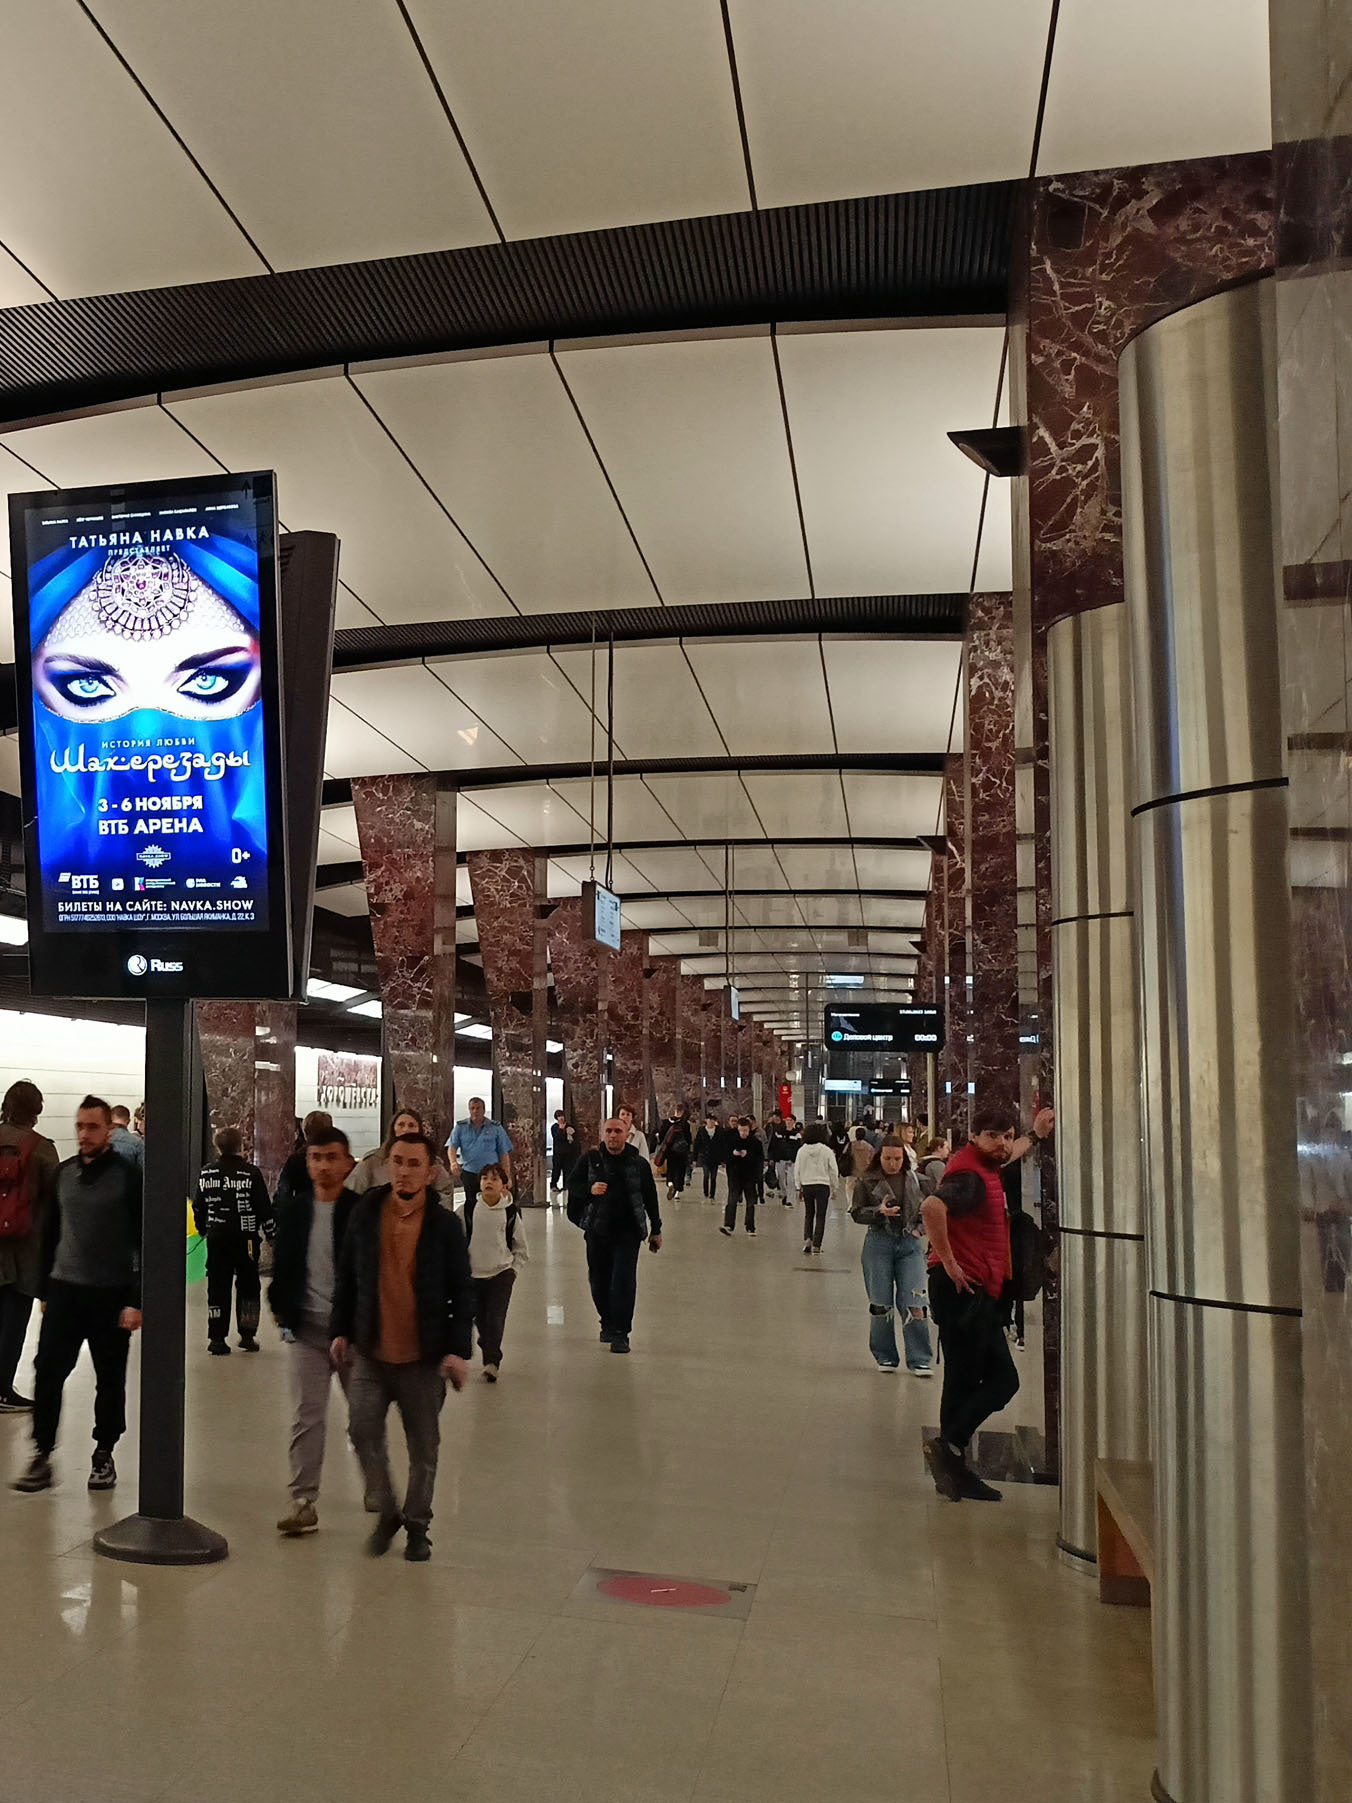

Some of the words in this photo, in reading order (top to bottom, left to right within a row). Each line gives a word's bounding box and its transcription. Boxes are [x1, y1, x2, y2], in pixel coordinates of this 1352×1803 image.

[70, 532, 143, 549] ТАТЬЯНА
[151, 526, 209, 543] НАВКА
[102, 740, 151, 749] ИСТОРИЯ
[156, 738, 195, 747] ЛЮБВИ
[50, 744, 251, 783] Шахерезады
[98, 799, 109, 812] 3
[121, 798, 132, 811] 6
[136, 796, 203, 811] НОЯБРЯ
[99, 820, 129, 835] ВТБ
[134, 818, 204, 834] АРЕНА
[232, 848, 250, 864] 0+
[72, 875, 99, 889] ВТБ
[58, 902, 102, 912] БИЛЕТЫ
[107, 902, 122, 911] НА
[126, 899, 167, 912] САЙТЕ:
[171, 900, 253, 911] NAVKA.SHOW
[151, 959, 184, 972] Russ
[199, 1178, 221, 1192] Palm
